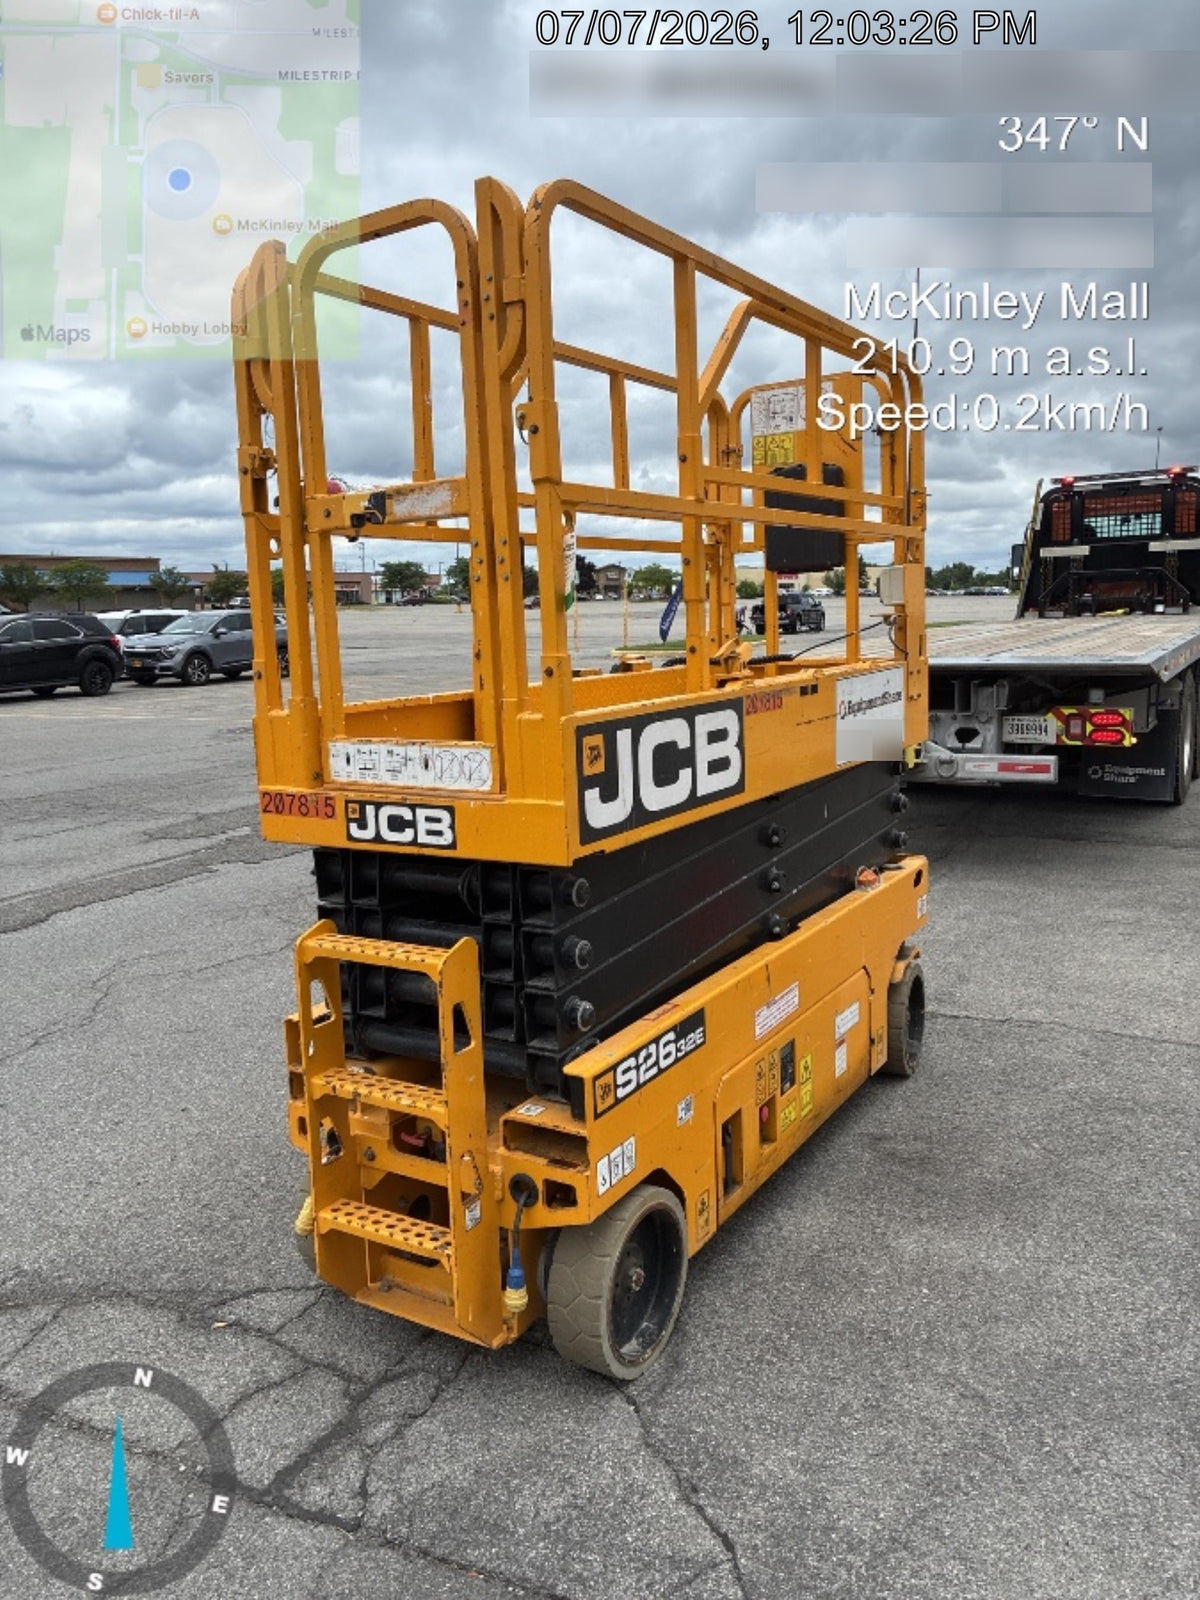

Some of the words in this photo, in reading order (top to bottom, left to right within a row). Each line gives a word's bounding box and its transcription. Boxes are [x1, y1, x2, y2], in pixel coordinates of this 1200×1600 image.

[584, 708, 742, 829] JCB
[349, 804, 454, 847] JCB
[616, 1030, 677, 1099] S26
